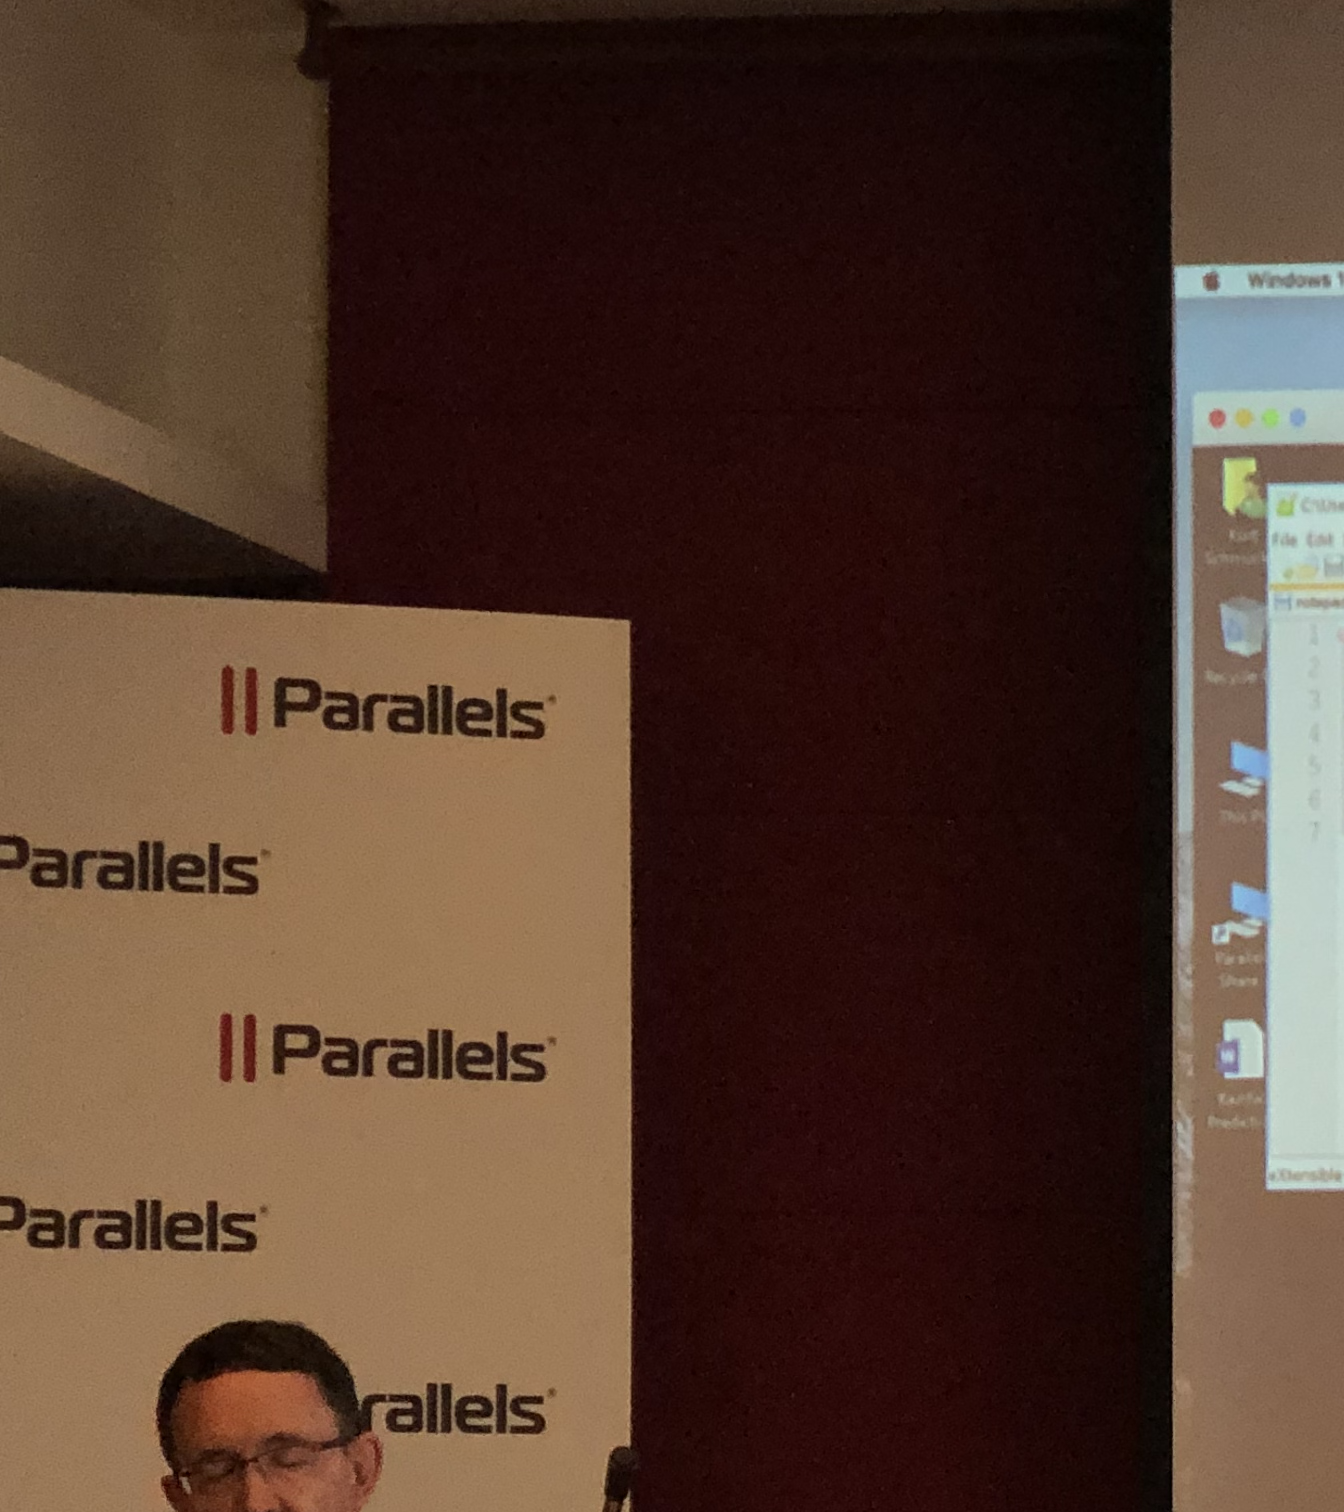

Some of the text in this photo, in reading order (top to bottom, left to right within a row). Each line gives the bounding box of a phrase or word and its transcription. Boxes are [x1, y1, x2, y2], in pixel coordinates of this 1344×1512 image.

[1247, 271, 1331, 289] Windows
[1271, 531, 1297, 548] File
[1306, 531, 1334, 547] Edit
[273, 676, 546, 740] Parallels
[272, 1023, 547, 1083] Parallels
[360, 1382, 546, 1435] rallels
